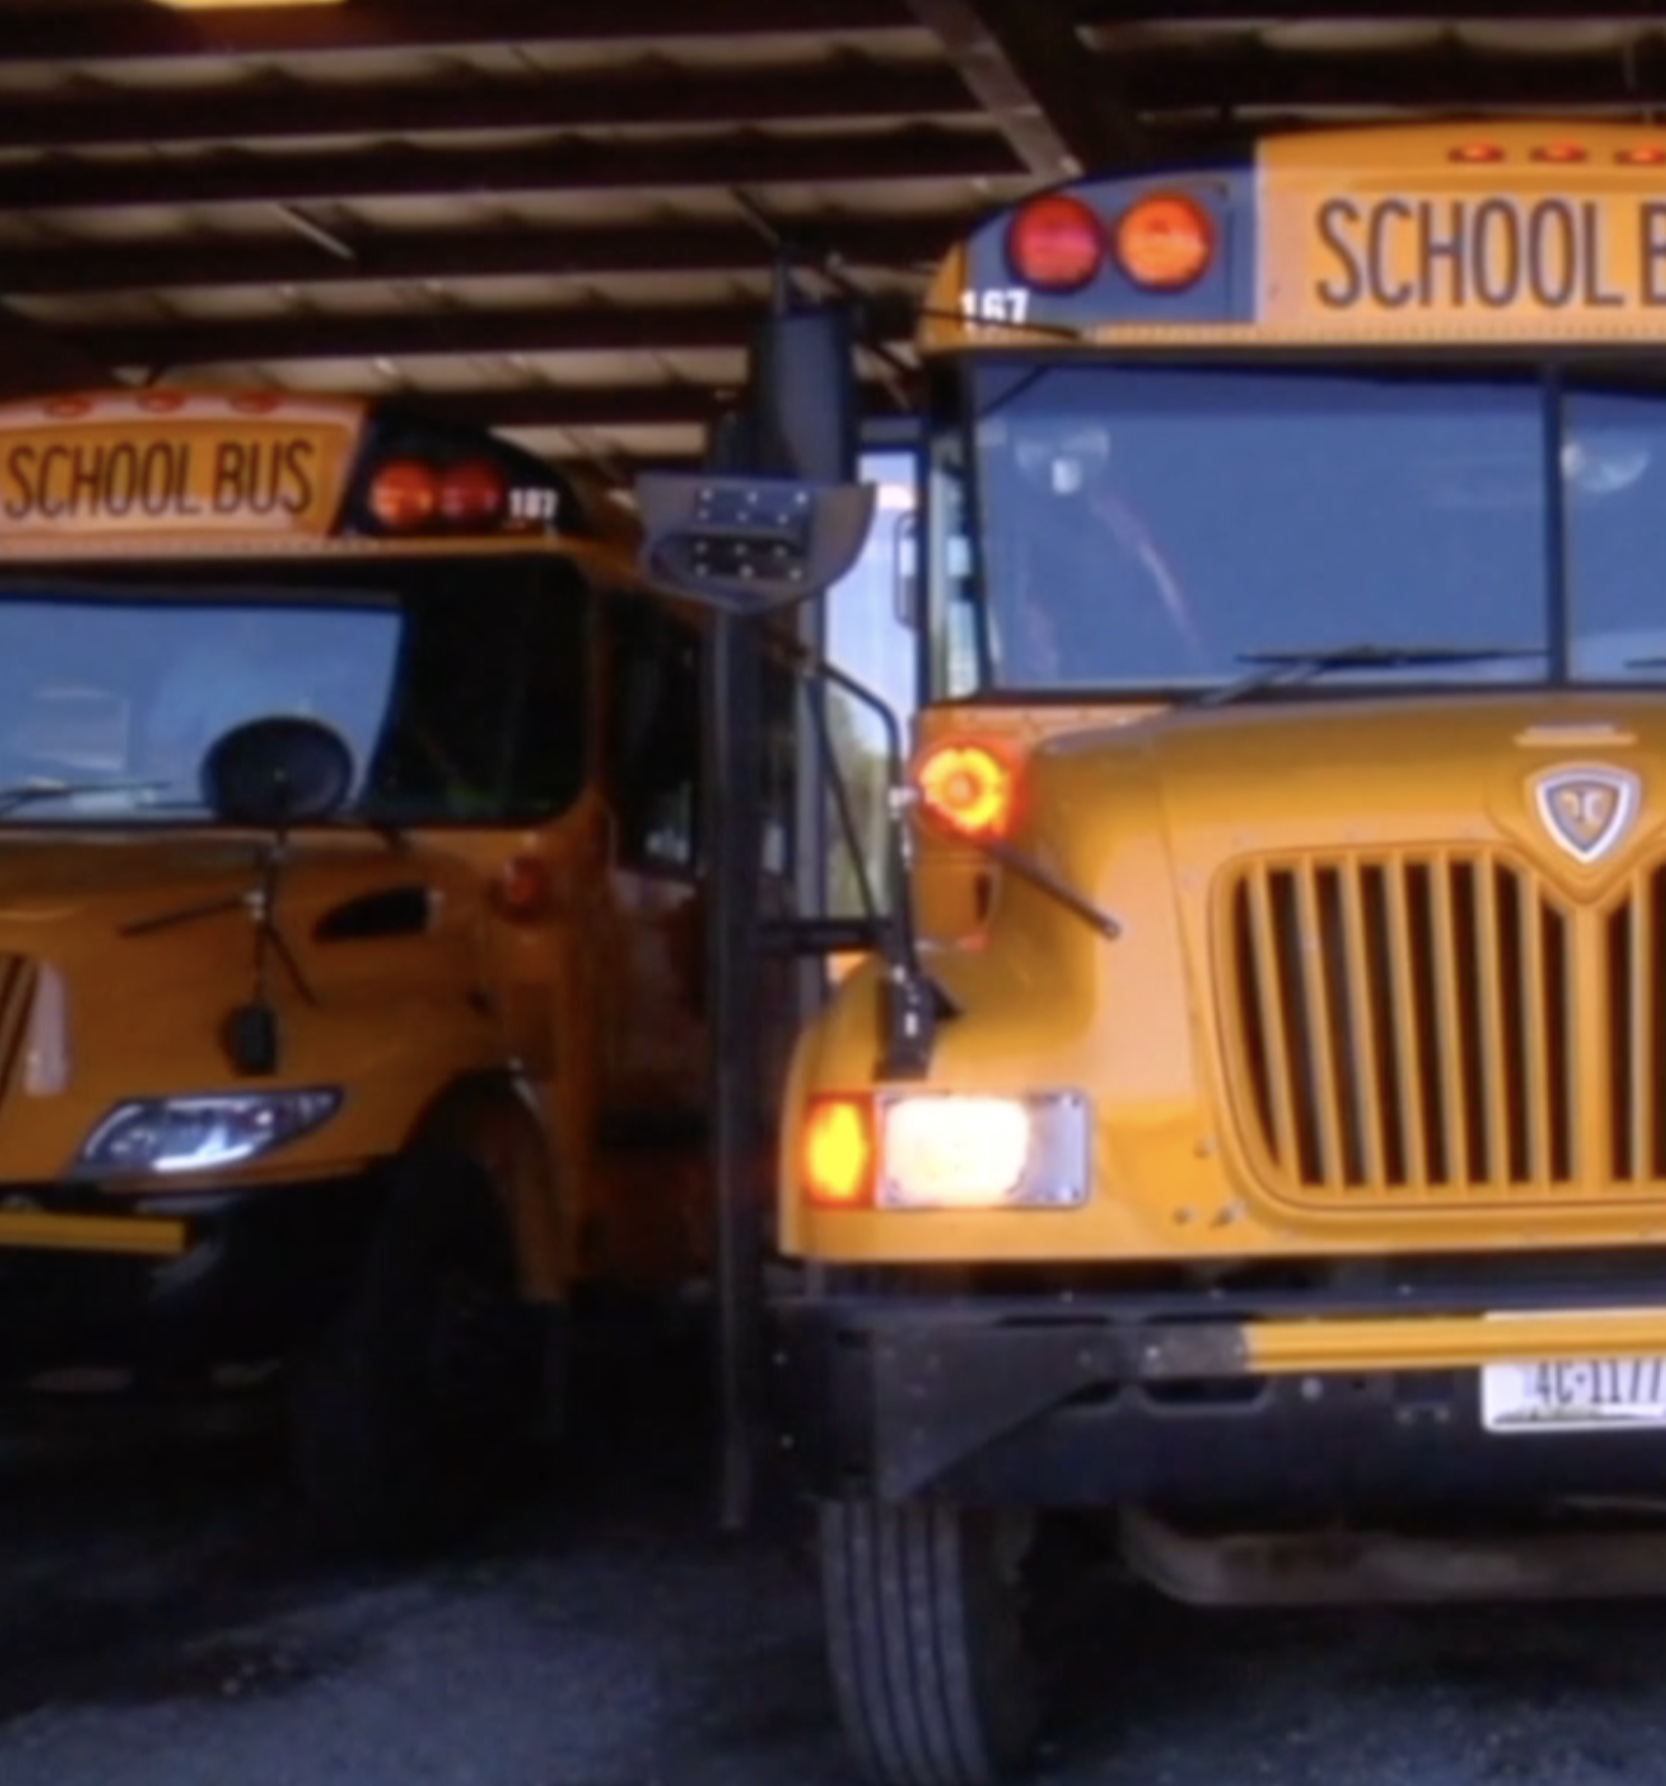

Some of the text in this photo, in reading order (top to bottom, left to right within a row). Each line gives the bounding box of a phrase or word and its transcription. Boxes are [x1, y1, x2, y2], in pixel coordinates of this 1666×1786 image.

[1315, 196, 1624, 309] SCHOOL
[960, 287, 1030, 324] 167
[4, 438, 315, 519] SCHOOL BUS
